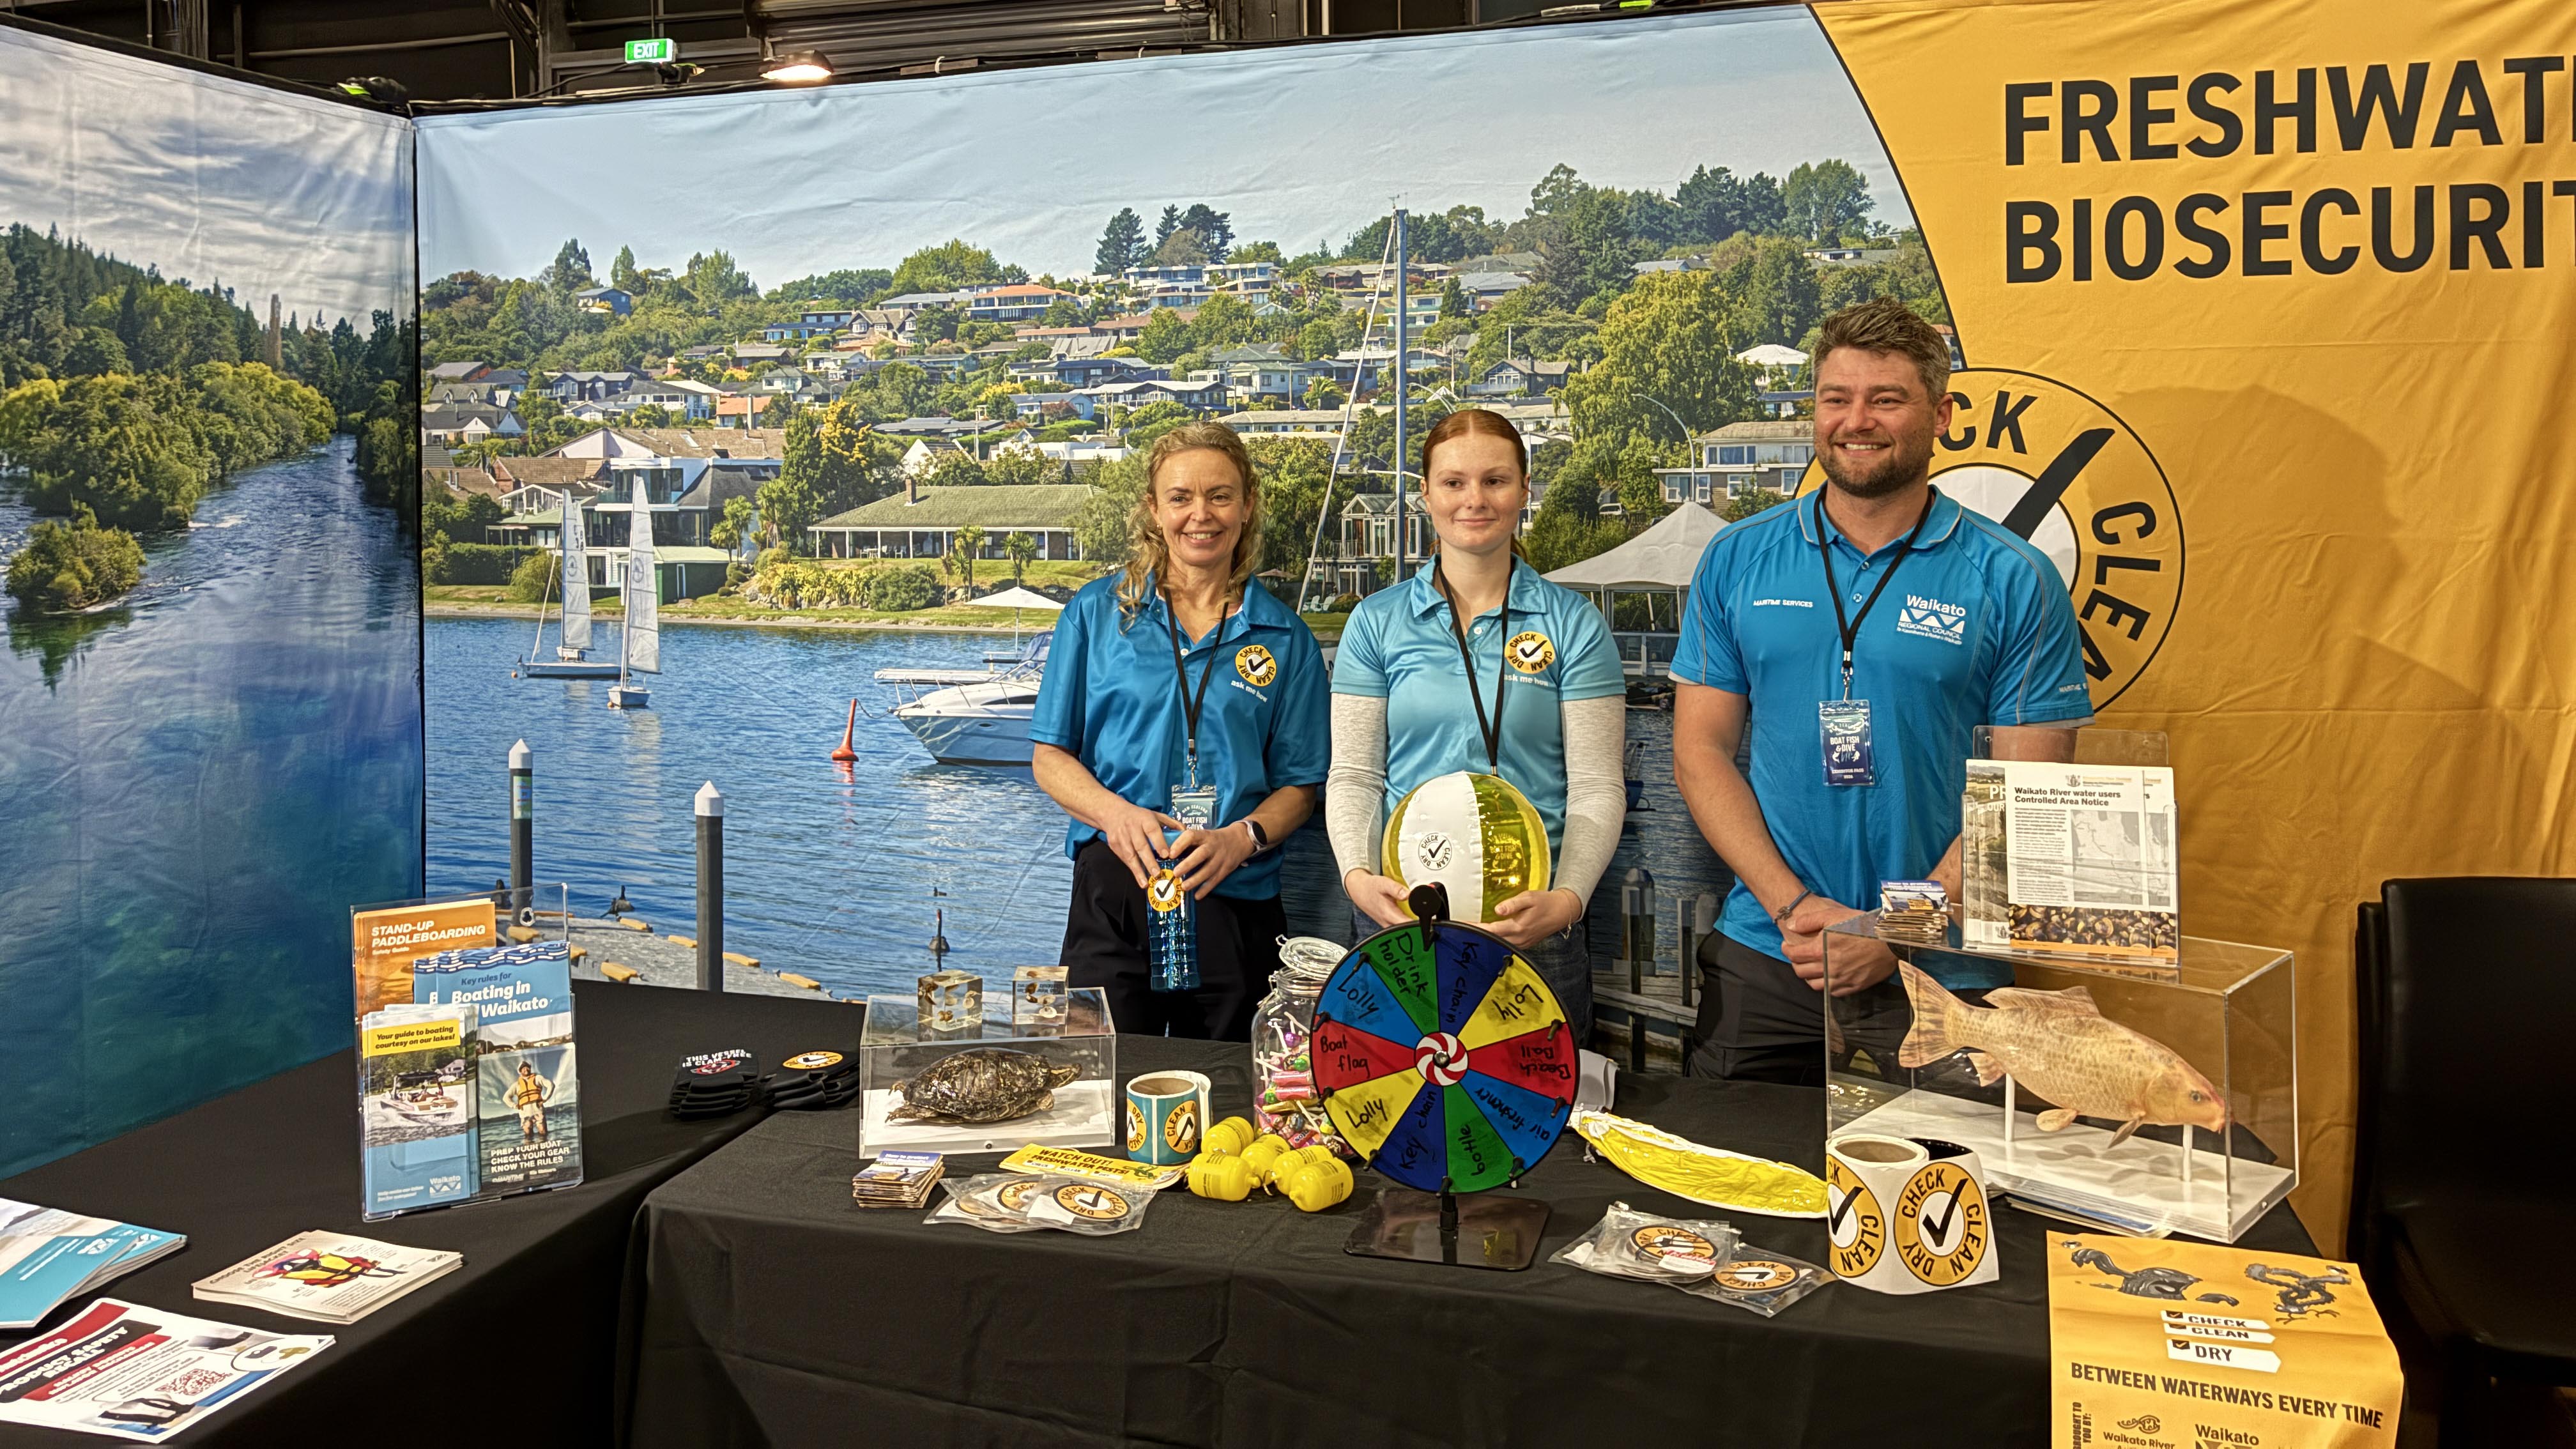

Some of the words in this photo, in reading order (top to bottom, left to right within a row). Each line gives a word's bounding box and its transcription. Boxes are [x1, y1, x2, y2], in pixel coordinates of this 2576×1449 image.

[633, 42, 659, 59] EXIT
[2004, 55, 2576, 166] FRESHWAT
[1906, 594, 1966, 617] Waikato
[1898, 622, 1930, 631] REGIONAL
[1932, 627, 1961, 640] COUNCIL
[1510, 634, 1537, 648] CHECK
[1239, 647, 1264, 658] CHECK
[1531, 650, 1552, 671] CLEAN
[1238, 664, 1251, 678] DRY
[1508, 656, 1524, 668] DRY
[1256, 666, 1275, 684] CLEAN
[1230, 680, 1245, 689] ask
[1246, 686, 1256, 695] me
[1830, 737, 1845, 745] BOAT
[2014, 787, 2047, 795] Waikato
[2050, 788, 2071, 797] River
[2082, 798, 2108, 806] Notice
[1421, 834, 1439, 848] CHECK
[1421, 855, 1431, 866] DRY
[1436, 847, 1450, 868] CLEAN
[1150, 896, 1160, 908] DRY
[371, 920, 434, 937] STAND-UP
[372, 925, 486, 947] PADDLEBOARDING
[1378, 939, 1411, 995] holder
[1395, 931, 1429, 997] Drink
[461, 977, 477, 986] Key
[478, 974, 498, 984] rules
[499, 972, 512, 983] for
[452, 983, 514, 1004] Boating
[516, 980, 531, 994] in
[1337, 966, 1380, 1020] Lolly
[1448, 976, 1468, 1023] chain
[481, 997, 549, 1018] Waikato
[1492, 983, 1544, 1020] Lolly
[375, 1039, 408, 1050] courtesy
[433, 1033, 456, 1043] lakes!
[376, 1032, 394, 1041] Your
[395, 1031, 415, 1041] guide
[425, 1026, 454, 1038] boating
[1320, 1034, 1349, 1053] Boat
[1521, 1043, 1554, 1059] Ball
[712, 1049, 746, 1059] VESSEL
[1337, 1054, 1369, 1078] flag
[1519, 1062, 1571, 1080] Beach
[1132, 1107, 1144, 1124] DRY
[1345, 1098, 1389, 1130] Lolly
[1418, 1090, 1437, 1130] chain
[1167, 1105, 1186, 1137] CLEAN
[1129, 1133, 1144, 1149] CHEC
[491, 1154, 521, 1165] CHECK
[523, 1151, 546, 1160] YOUR
[547, 1147, 570, 1156] GEAR
[491, 1163, 518, 1173] KNOW
[519, 1160, 535, 1169] THE
[537, 1156, 564, 1166] RULES
[1031, 1155, 1095, 1169] FRESHWATER
[1096, 1165, 1130, 1175] PESTS!
[1039, 1149, 1082, 1162] WATCH
[1083, 1155, 1114, 1167] OUT!
[429, 1175, 461, 1184] Waikato
[1061, 1187, 1088, 1200] CHECK
[1902, 1169, 1945, 1218] CHECK
[1071, 1205, 1094, 1216] DRY
[1840, 1215, 1879, 1271] CLEAN
[1949, 1203, 1982, 1276] CLEAN
[1903, 1241, 1935, 1276] DRY
[2188, 1315, 2247, 1328] CHECK
[2191, 1328, 2250, 1339] CLEAN
[2195, 1346, 2232, 1361] DRY
[2071, 1362, 2157, 1391] BETWEEN
[2161, 1377, 2273, 1409] WATERWAYS
[2279, 1395, 2337, 1419] EVERY
[2341, 1404, 2383, 1430] TIME
[2083, 1413, 2091, 1426] BY:
[2083, 1427, 2091, 1443] YOU
[2103, 1431, 2147, 1446] Waikato
[2149, 1438, 2175, 1449] River
[2195, 1423, 2260, 1446] Waikato
